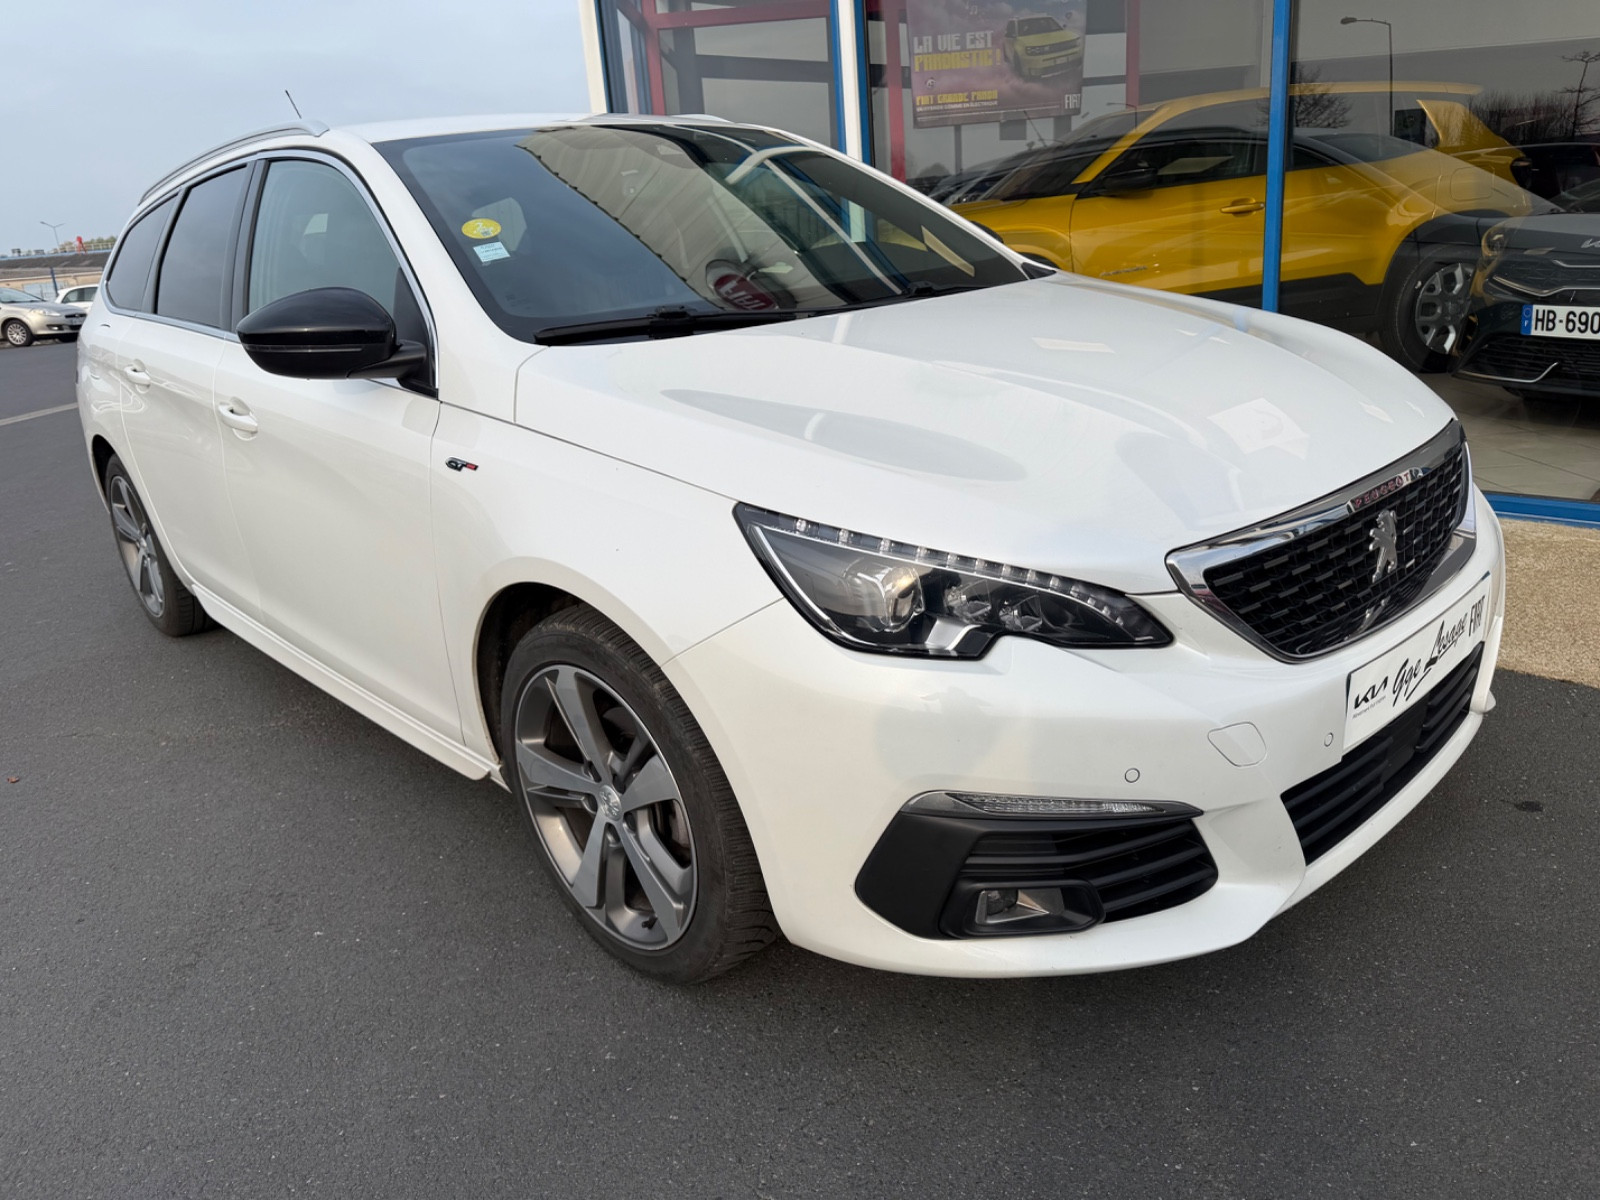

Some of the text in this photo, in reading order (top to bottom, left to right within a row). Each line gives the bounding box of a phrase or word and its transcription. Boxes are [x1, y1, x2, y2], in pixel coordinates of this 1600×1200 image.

[914, 30, 993, 53] LA VIE EST
[1064, 93, 1081, 109] FIAT
[1534, 309, 1600, 334] HB-690
[1354, 472, 1410, 508] PEUGEOT
[1468, 595, 1485, 637] FIAT
